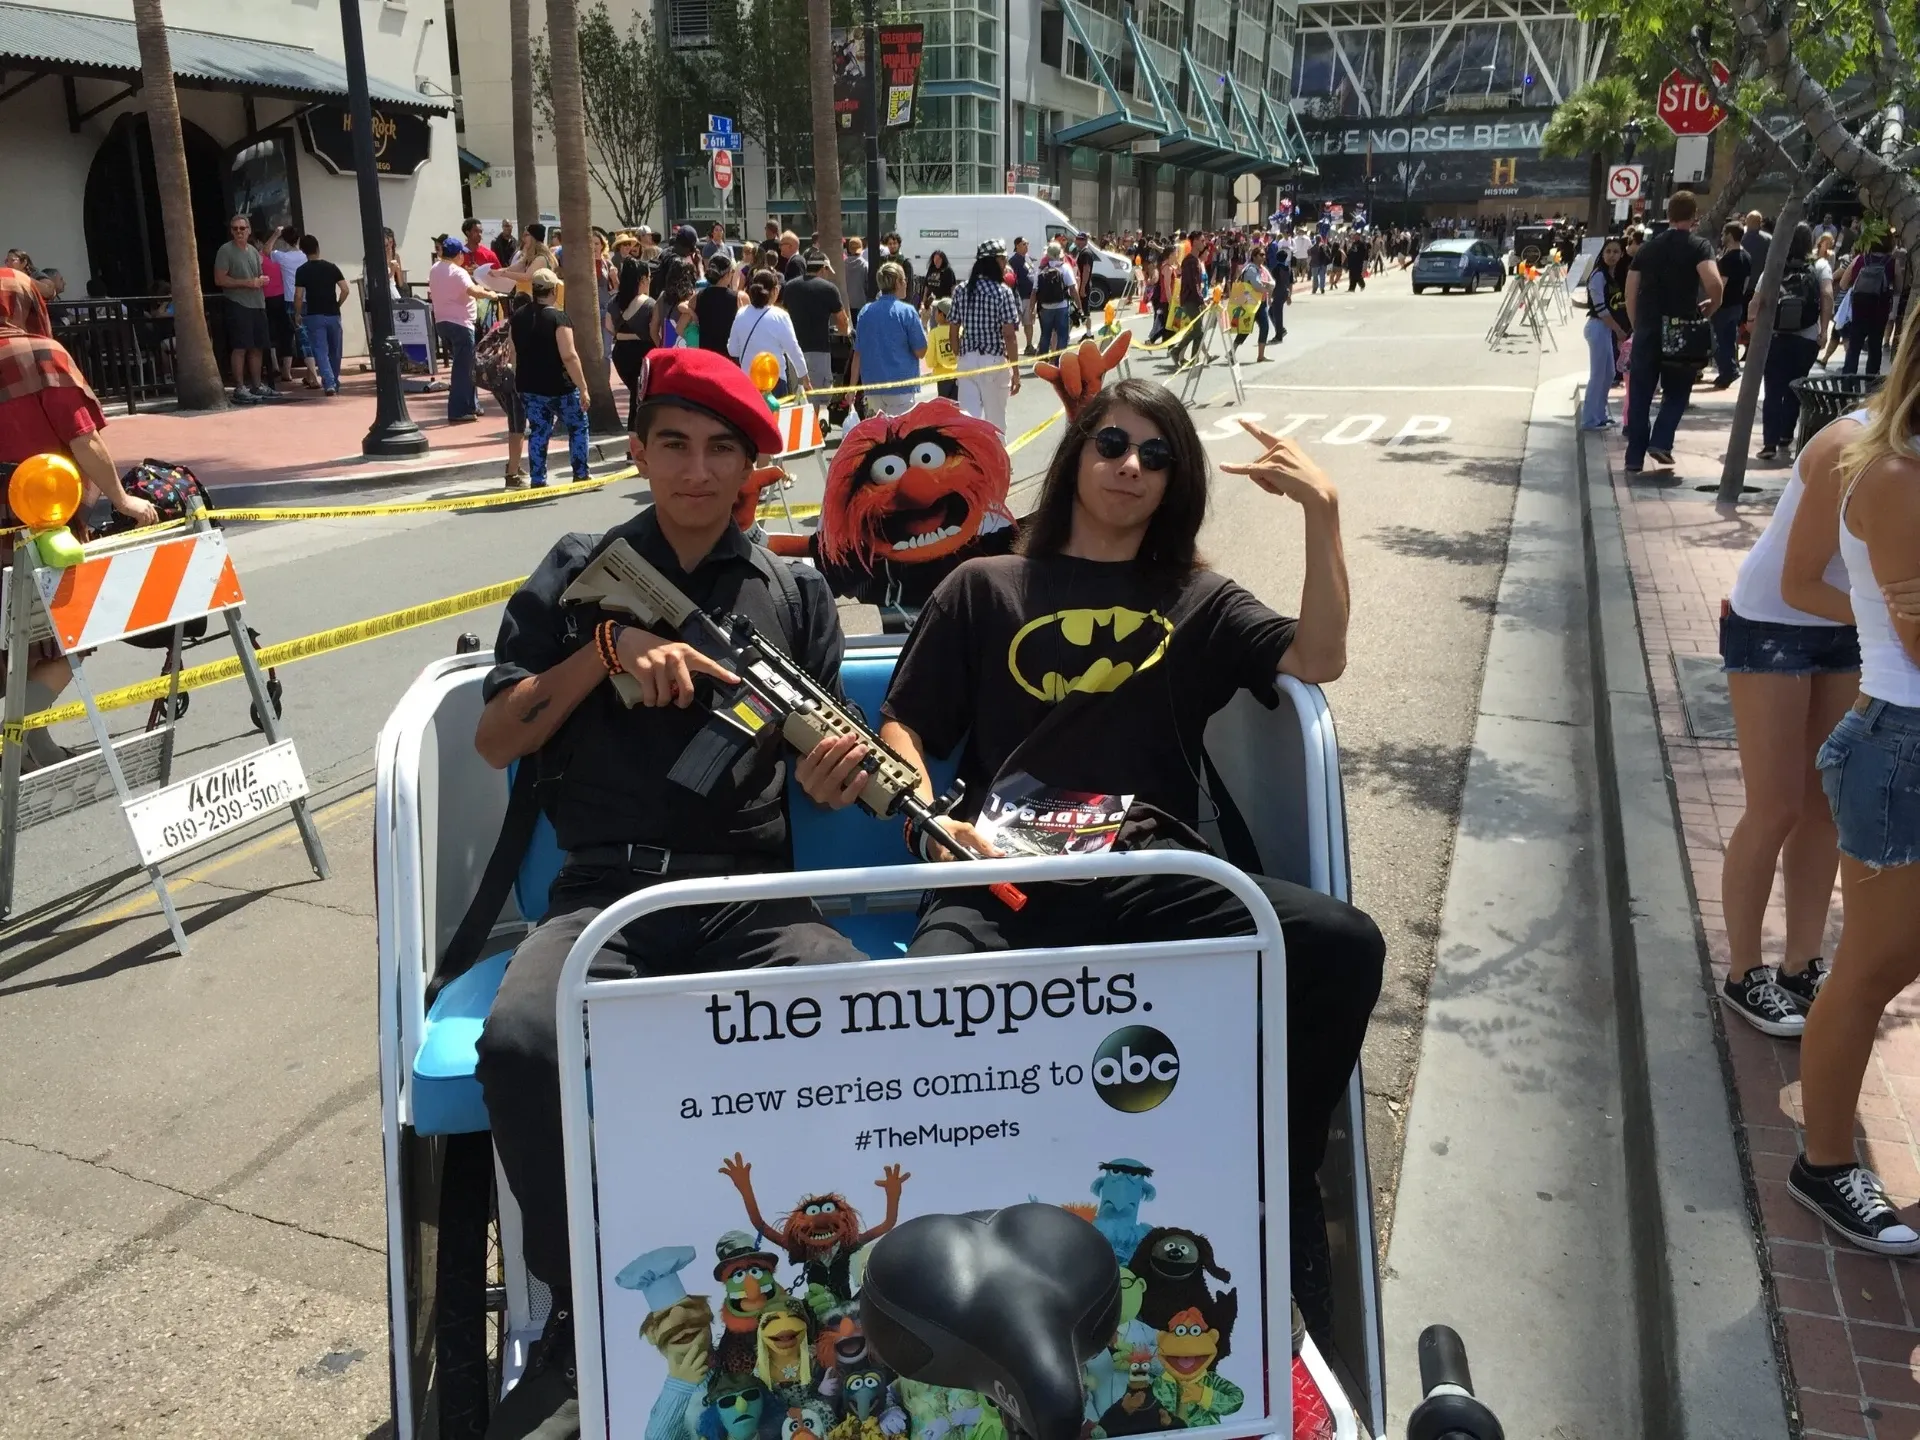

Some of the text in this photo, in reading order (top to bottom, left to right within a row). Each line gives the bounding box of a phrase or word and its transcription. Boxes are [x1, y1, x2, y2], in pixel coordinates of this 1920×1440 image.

[881, 32, 922, 44] CELEBRATING
[883, 53, 921, 68] POPULAR
[892, 69, 914, 84] ARTS
[890, 91, 899, 120] COMIC
[1663, 84, 1710, 112] STO
[372, 116, 397, 139] Rock
[710, 136, 726, 147] 6TH
[1368, 126, 1466, 152] NORSE
[1474, 124, 1511, 147] BE
[1484, 188, 1519, 196] HISTORY
[1199, 411, 1453, 447] STOP
[188, 762, 258, 812] ACME
[991, 792, 1126, 825] DEADPOOL
[705, 965, 1153, 1045] the muppets.
[680, 1045, 1180, 1119] a new series coming to abc
[854, 1119, 1021, 1151] #TheMuppets
